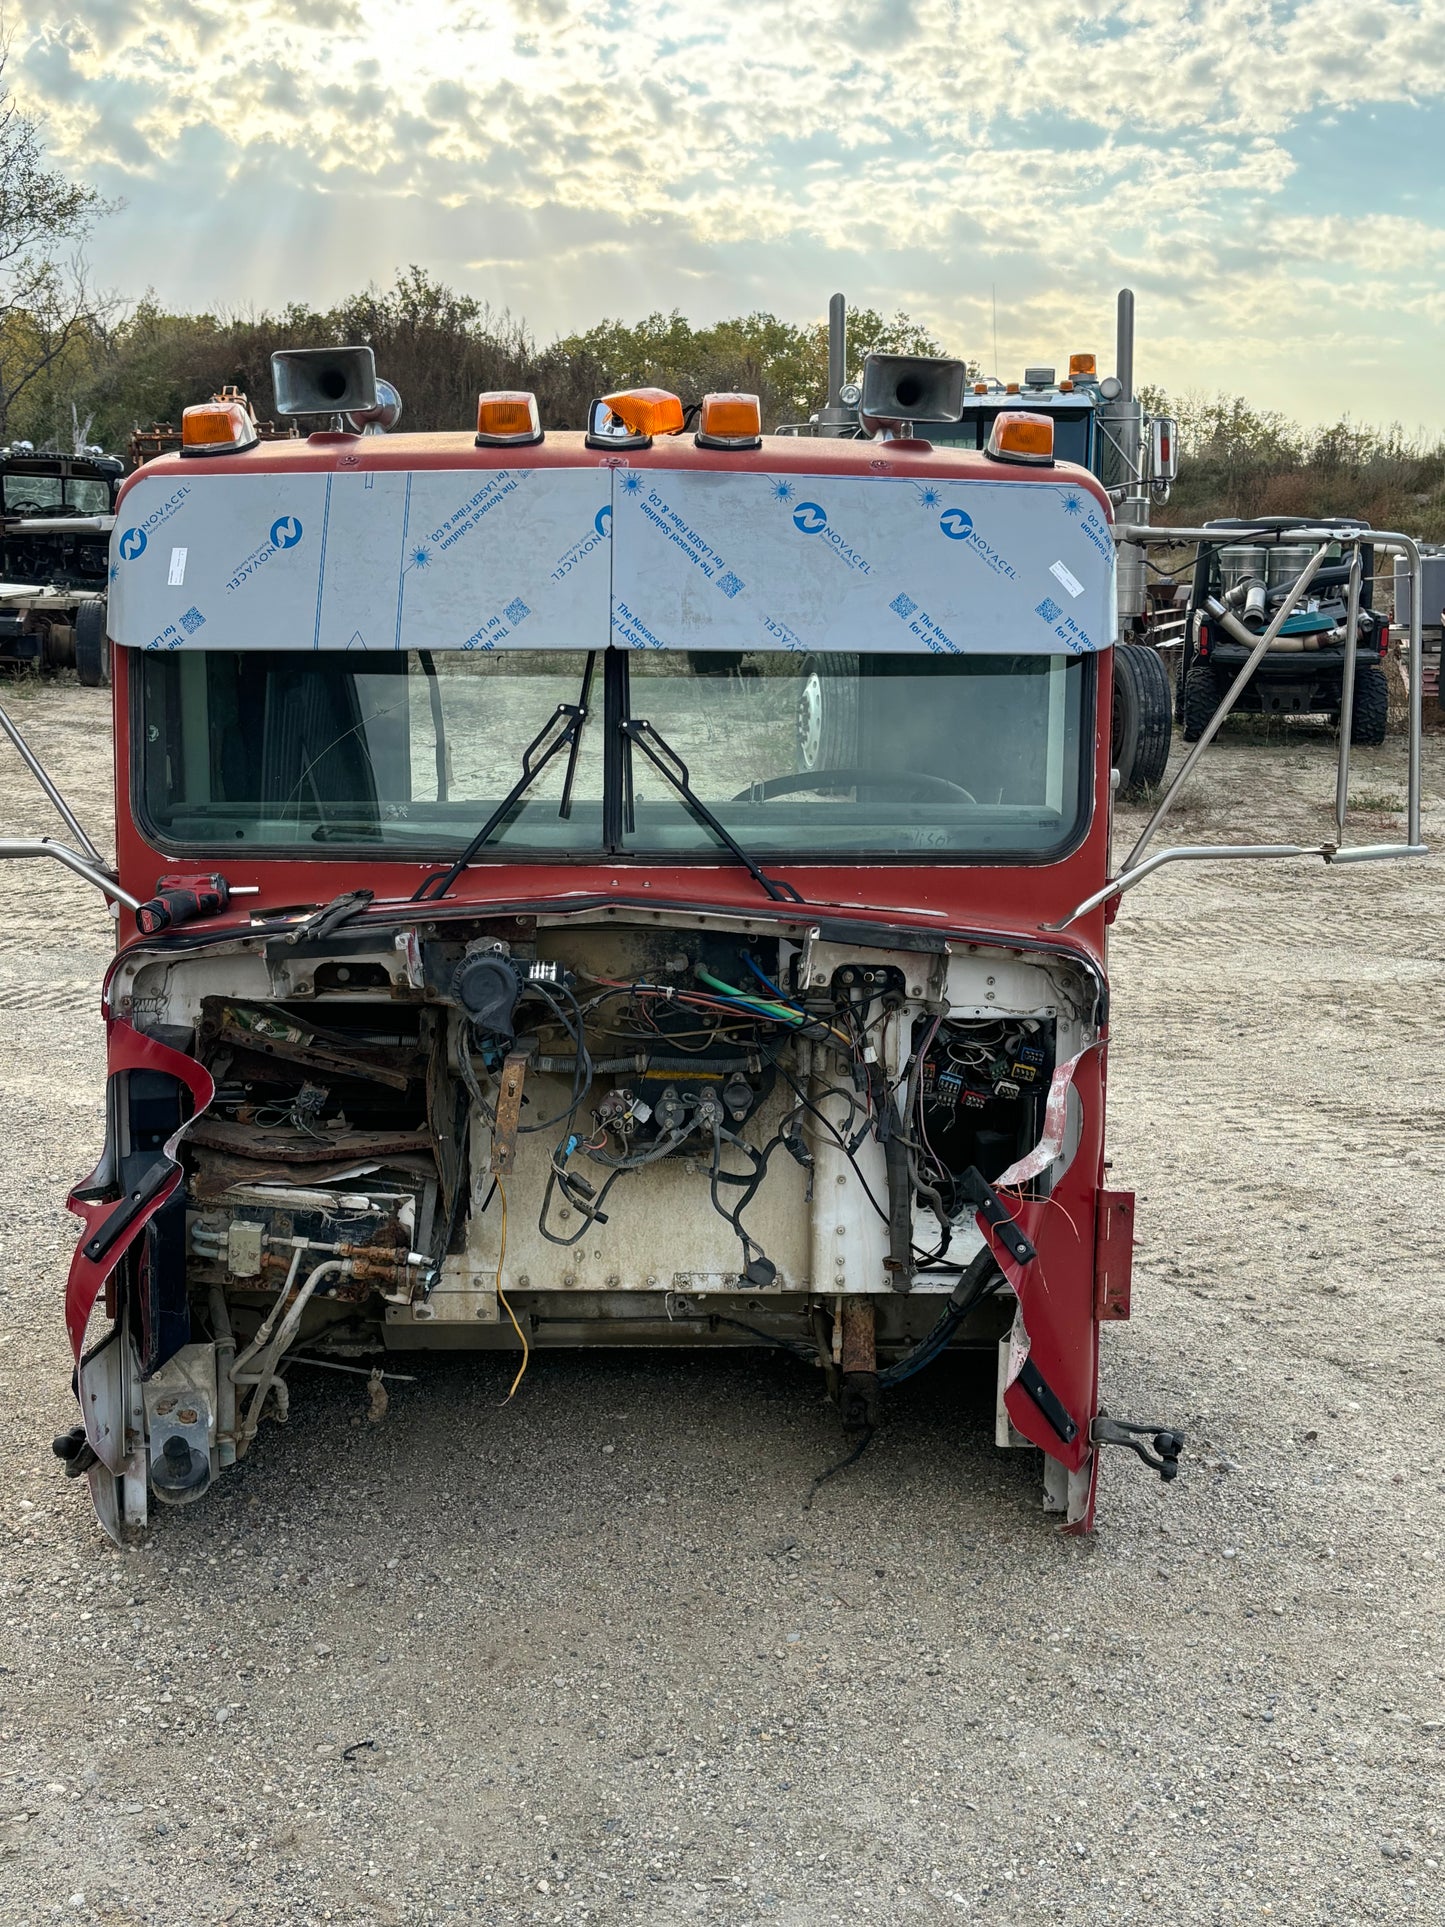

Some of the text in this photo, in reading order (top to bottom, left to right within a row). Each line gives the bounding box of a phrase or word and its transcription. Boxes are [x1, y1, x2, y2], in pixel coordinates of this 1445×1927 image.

[496, 468, 509, 482] for
[470, 481, 497, 506] LASER
[141, 487, 191, 534] NOVACEL
[440, 480, 518, 550] The Novacel Solution
[451, 504, 472, 524] Fiber
[668, 513, 688, 533] Fiber
[640, 503, 714, 578] The Novacel Solution
[687, 531, 713, 557] LASER
[1081, 522, 1106, 555] Solution
[551, 531, 601, 580] NOVACEL
[824, 527, 870, 575] NOVACEL
[970, 533, 1015, 580] NOVACEL
[226, 541, 276, 589] NOVACEL
[712, 556, 725, 569] for
[487, 616, 500, 629] for
[617, 603, 664, 651] The Novacel
[909, 622, 922, 634] for
[920, 612, 933, 629] The
[1065, 617, 1078, 633] The
[163, 625, 176, 637] for
[493, 627, 510, 641] The
[1055, 626, 1067, 638] for
[169, 635, 184, 650] The
